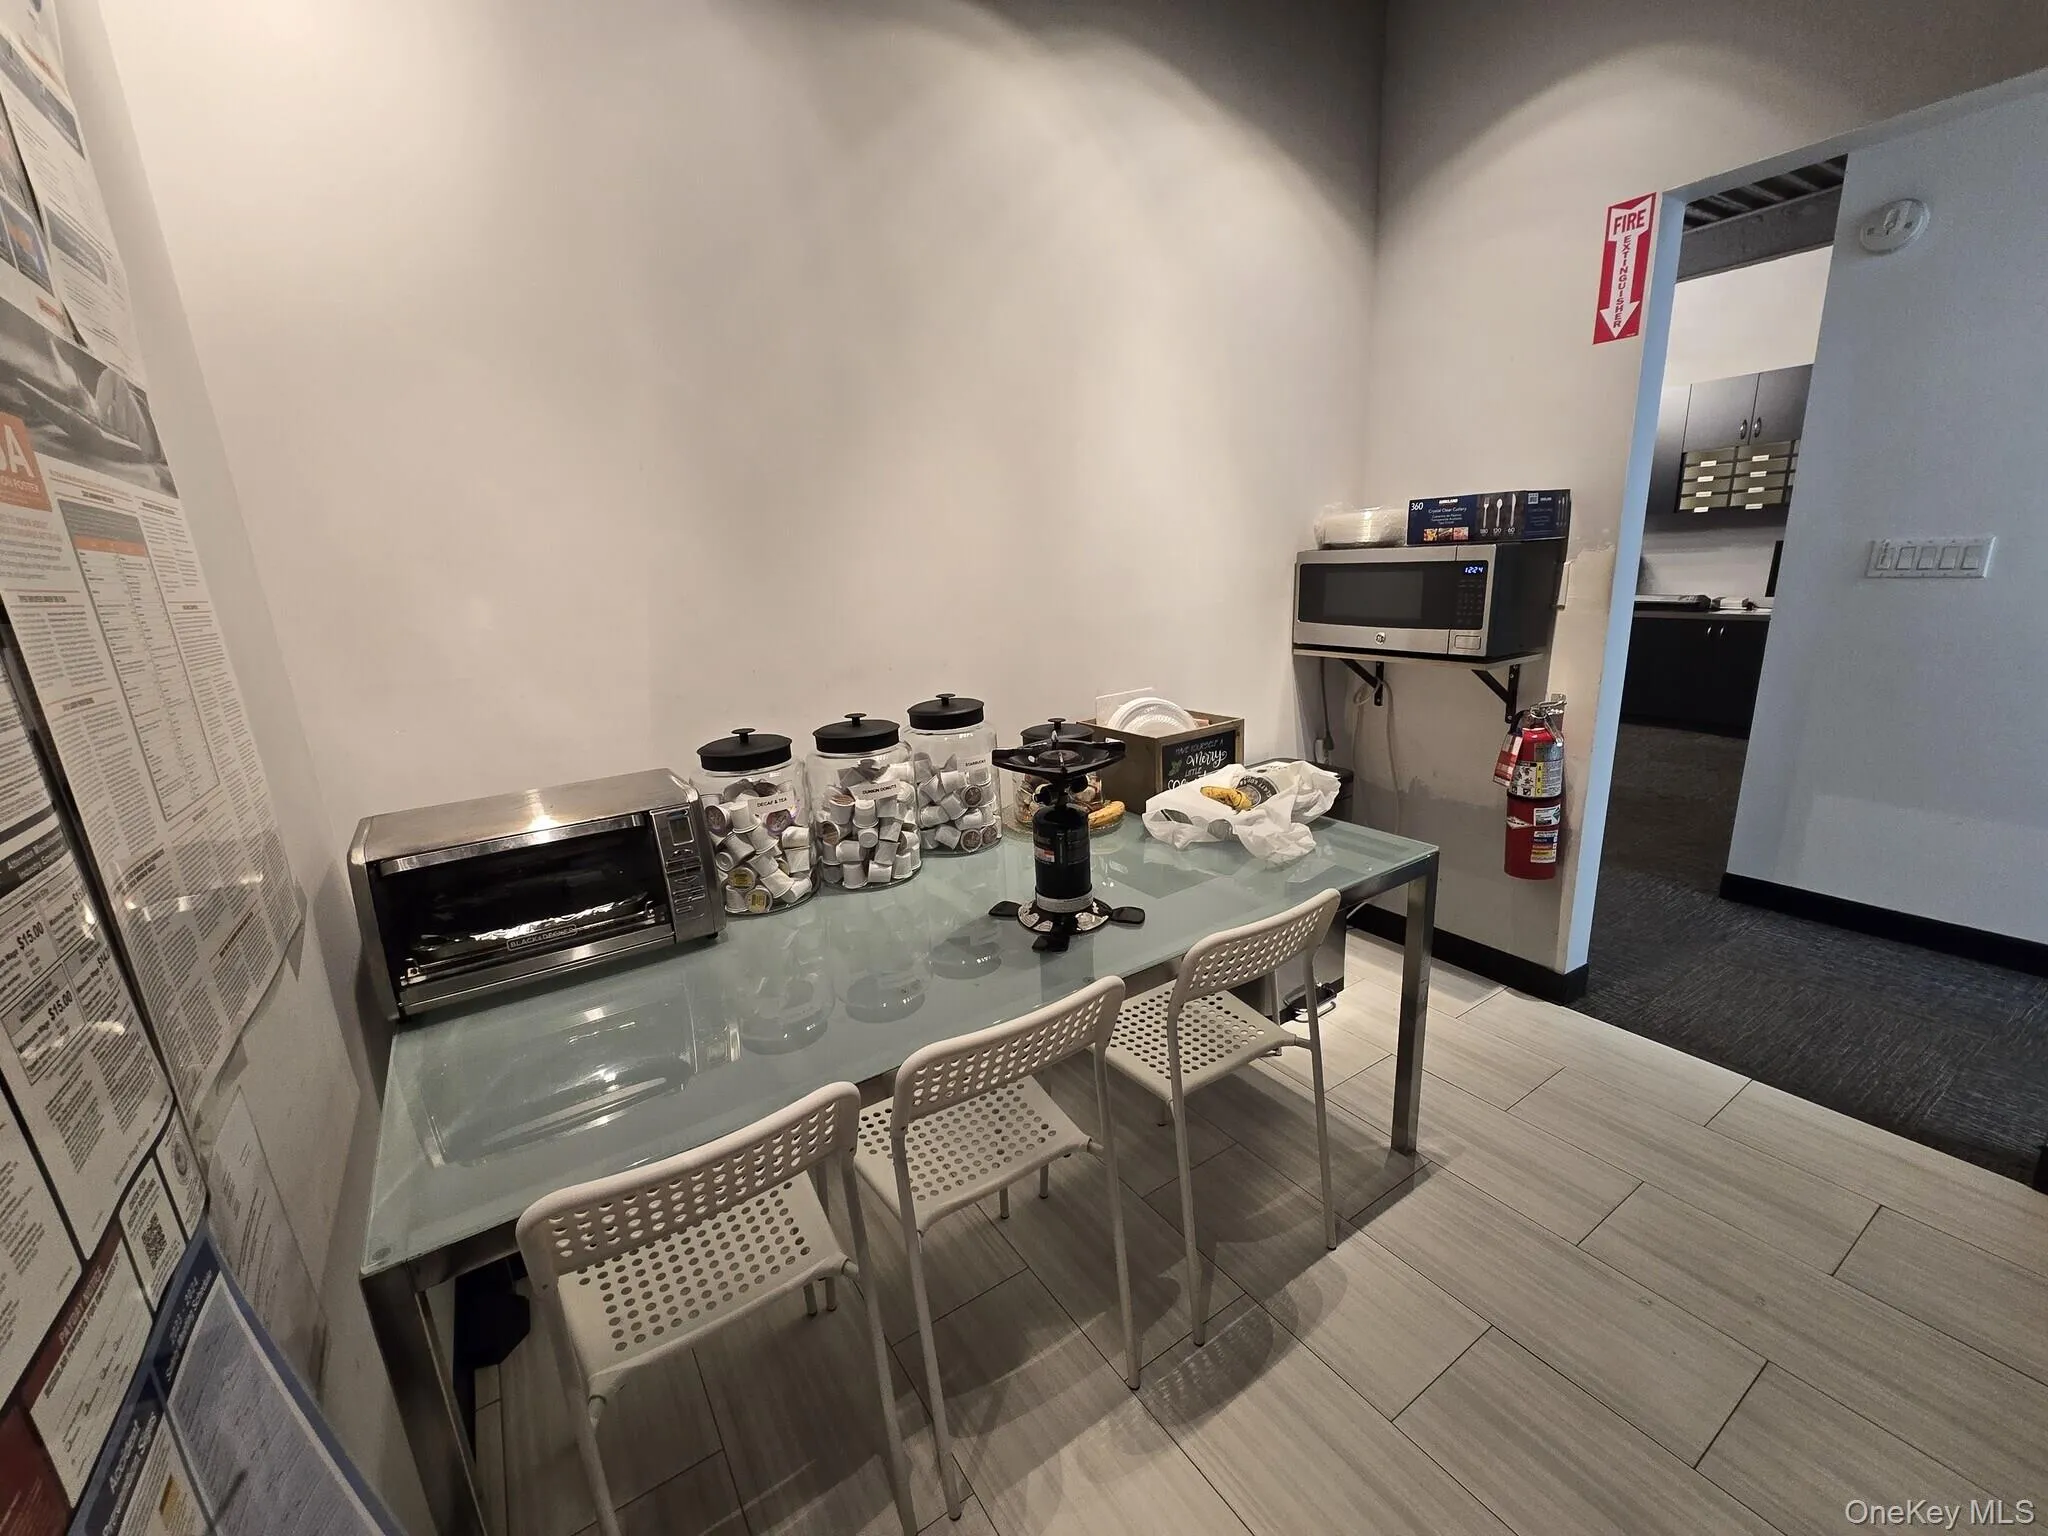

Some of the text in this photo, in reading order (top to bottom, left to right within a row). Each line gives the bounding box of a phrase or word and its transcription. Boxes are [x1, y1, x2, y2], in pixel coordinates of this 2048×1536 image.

[1613, 208, 1647, 235] FIRE
[1613, 234, 1632, 329] EXTINGUISHER
[1411, 502, 1424, 511] 360
[1190, 738, 1220, 752] YOURSELF
[1186, 749, 1228, 769] Merry
[1185, 767, 1203, 778] LITTLE
[16, 921, 44, 950] $15.00
[48, 990, 73, 1021] $15.00
